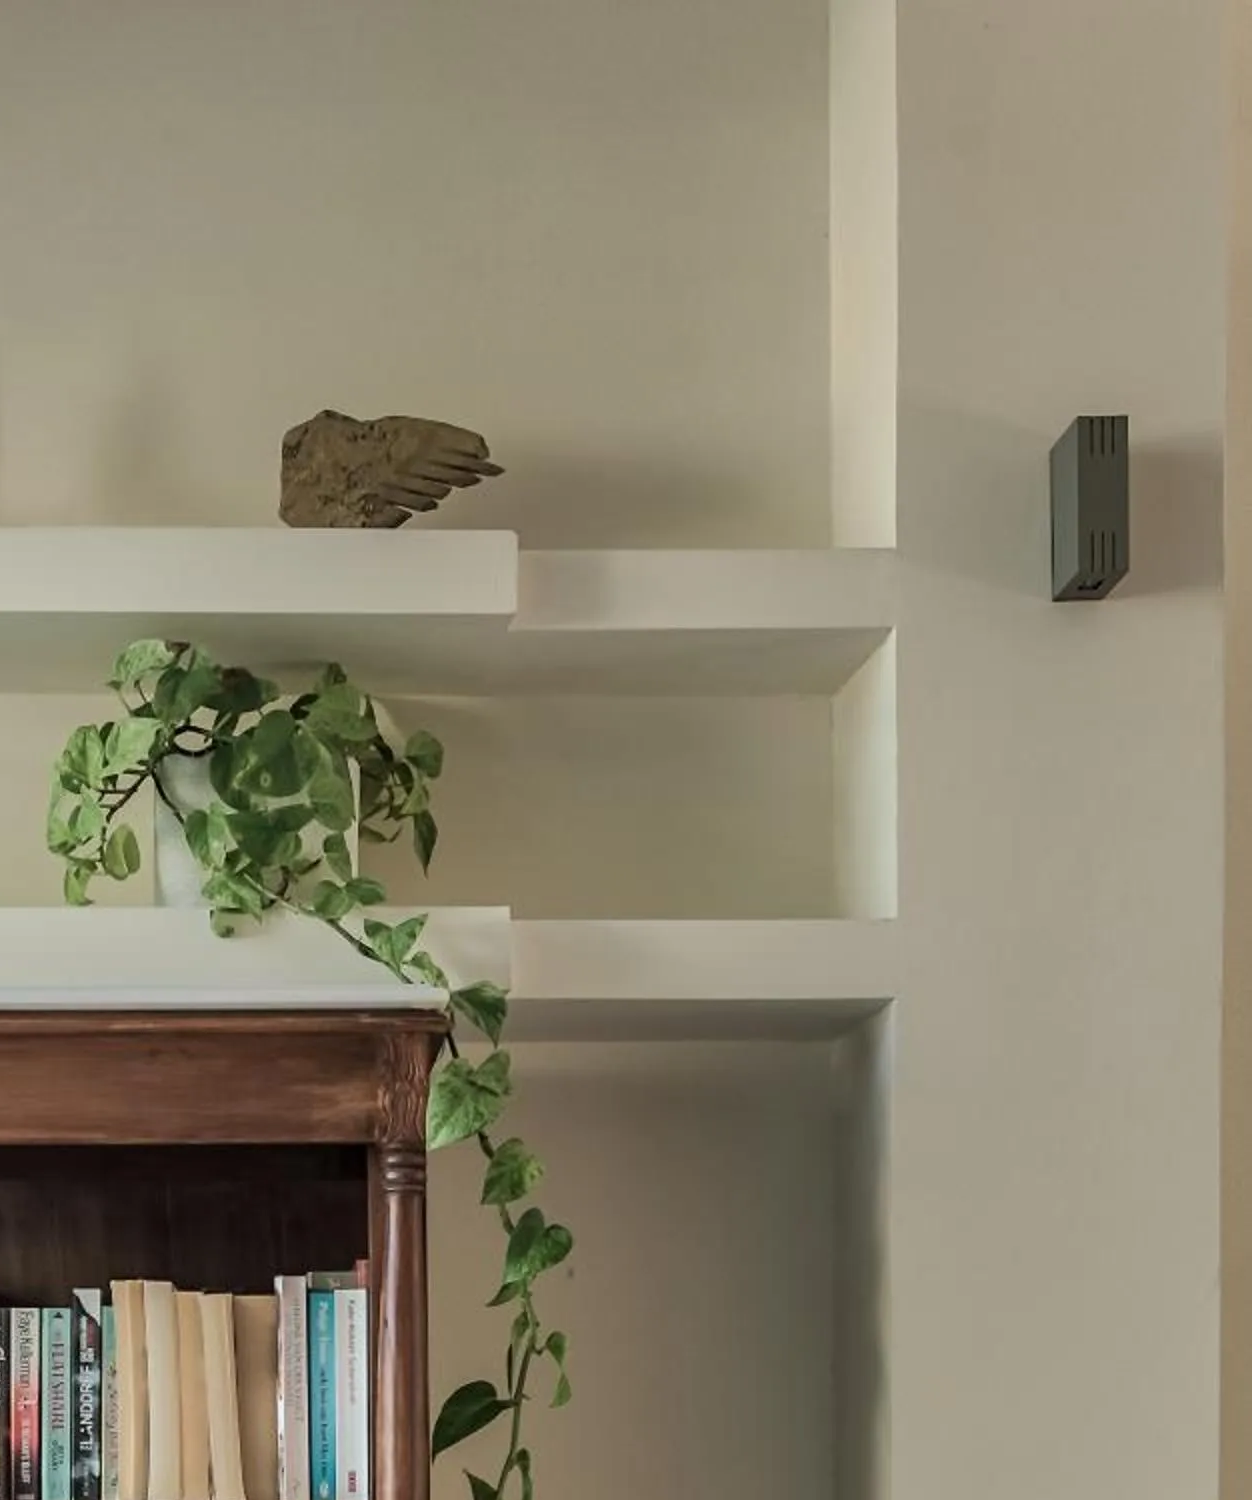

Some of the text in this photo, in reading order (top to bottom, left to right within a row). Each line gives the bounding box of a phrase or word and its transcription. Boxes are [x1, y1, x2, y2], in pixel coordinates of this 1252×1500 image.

[17, 1311, 32, 1388] Faye Kellerman
[51, 1342, 65, 1431] FLATSHARE
